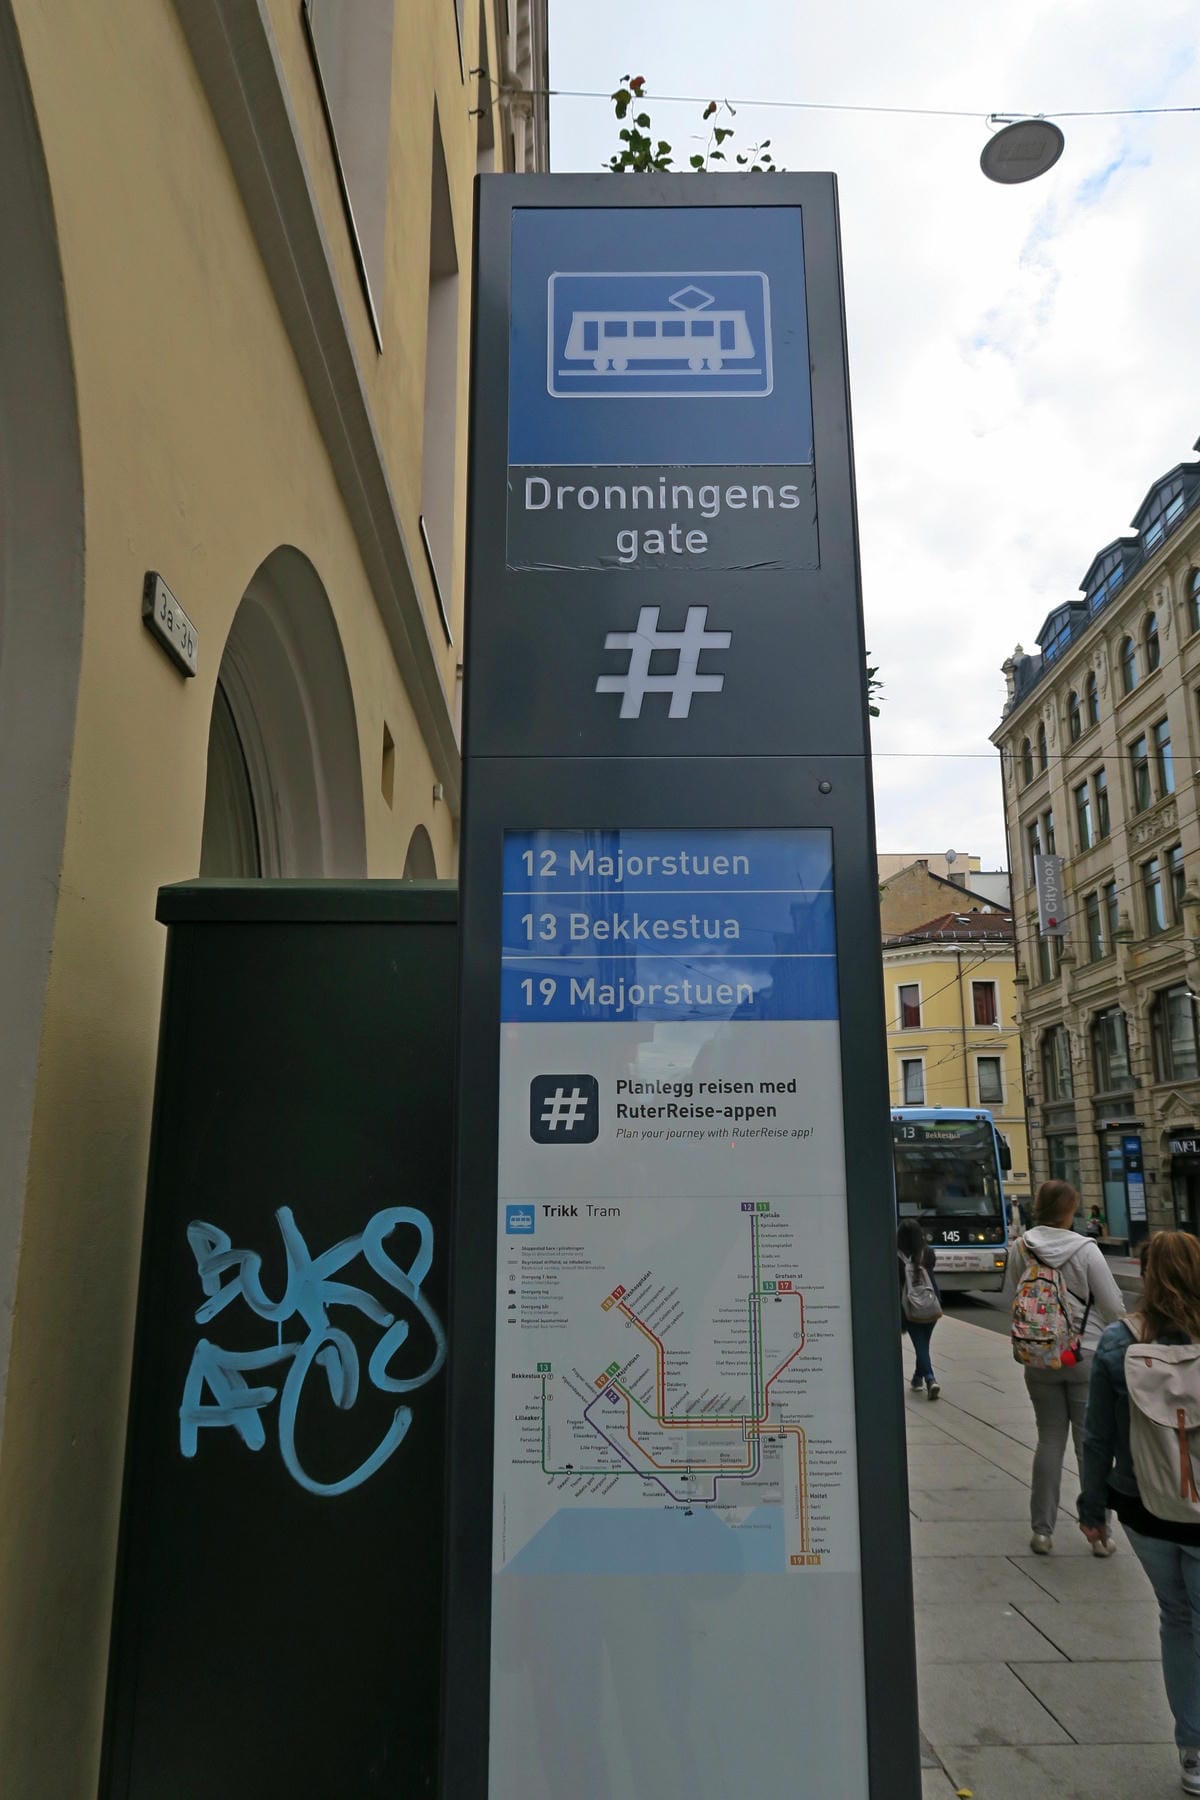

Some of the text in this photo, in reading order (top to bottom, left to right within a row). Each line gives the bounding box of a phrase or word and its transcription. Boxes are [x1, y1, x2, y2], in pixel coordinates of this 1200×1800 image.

[525, 477, 801, 518] Dronningens
[616, 523, 709, 563] gate
[521, 850, 750, 882] 12 Majorstuen
[1043, 861, 1058, 912] Citybox
[520, 912, 740, 940] 13 Bekkestua
[520, 977, 754, 1012] 19 Majorstuen
[616, 1079, 797, 1098] Planlegg reisen med
[616, 1103, 777, 1122] RuterReise-appen
[616, 1127, 814, 1141] Plan your journey with RuterReise app!
[902, 1127, 961, 1140] 13 Bekkestua
[542, 1205, 621, 1217] Trikk Tram
[942, 1231, 960, 1242] 145
